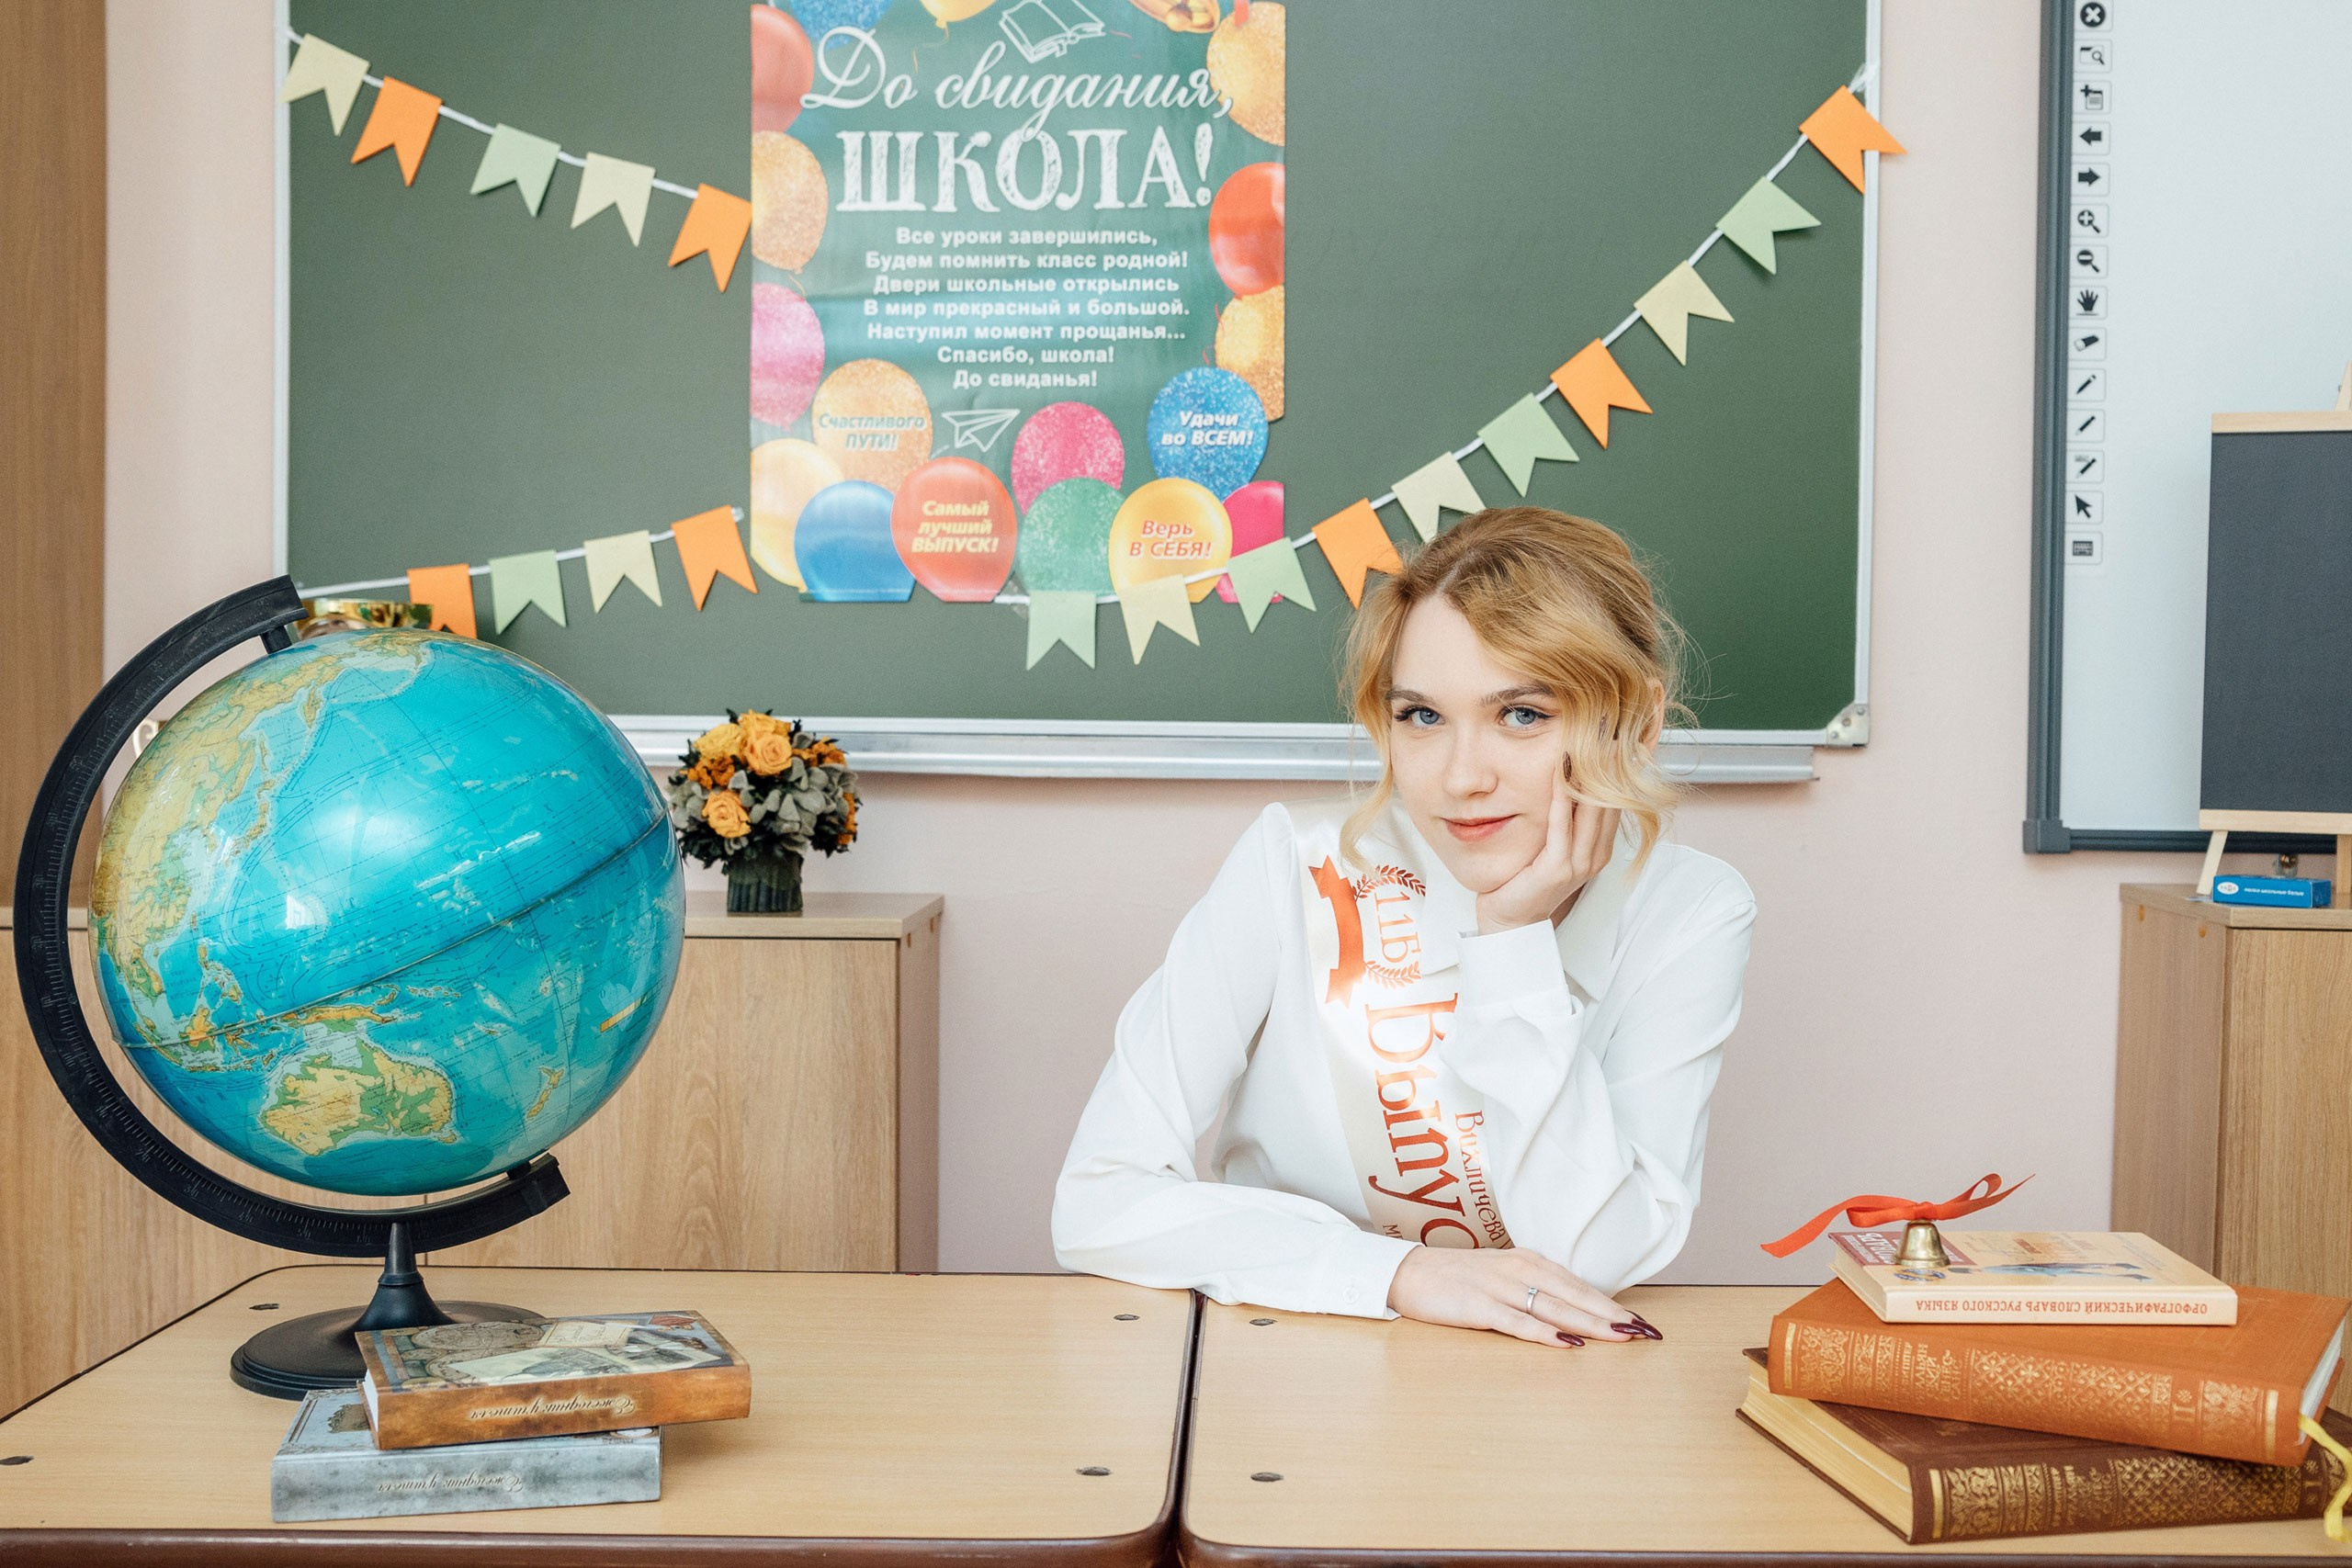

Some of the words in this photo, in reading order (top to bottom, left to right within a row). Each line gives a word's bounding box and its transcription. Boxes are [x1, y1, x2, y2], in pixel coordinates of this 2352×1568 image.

[800, 26, 918, 108] До
[934, 40, 1232, 141] свидания,
[836, 123, 1212, 211] ШКОЛА!
[896, 228, 934, 244] Все
[941, 230, 1002, 247] уроки
[1008, 230, 1158, 246] завершились,
[865, 252, 933, 270] Будем
[940, 254, 1030, 268] помнить
[1036, 254, 1096, 268] класс
[1102, 252, 1188, 269] родной!
[873, 276, 940, 295] Двери
[947, 278, 1057, 292] школьные
[1063, 277, 1180, 293] открылись
[864, 299, 878, 315] В
[886, 301, 926, 318] мир
[933, 299, 1061, 318] прекрасный
[1069, 302, 1080, 315] и
[1087, 299, 1190, 316] большой.
[867, 323, 967, 343] Наступил
[974, 325, 1054, 339] момент
[1060, 325, 1185, 343] прощанья...
[937, 346, 1035, 366] Спасибо,
[1041, 346, 1114, 363] школа!
[953, 370, 983, 389] До
[989, 370, 1097, 389] свиданья!
[819, 413, 926, 430] Счастливого
[1179, 411, 1238, 428] Удачи
[845, 434, 899, 450] ПУТИ!
[1160, 433, 1186, 446] во
[1192, 429, 1254, 446] ВСЕМ!
[922, 500, 989, 516] Самый
[918, 518, 993, 537] лучший
[1141, 520, 1193, 539] Верь
[911, 536, 1000, 553] ВЫПУСК!
[1129, 541, 1142, 557] В
[1150, 541, 1212, 558] СЕБЯ!
[1372, 891, 1421, 964] 11Б
[1916, 1300, 1958, 1311] ЯЗЫКА
[1962, 1300, 2021, 1312] РУССКОГО
[2025, 1301, 2081, 1313] СЛОВАРЬ
[2085, 1302, 2208, 1315] ОРФОГРАФИЧЕСКИЙ
[470, 1396, 541, 1419] учителя
[543, 1393, 635, 1415] Ежегодник
[378, 1472, 440, 1493] учителя
[443, 1471, 524, 1493] Ежегодник
